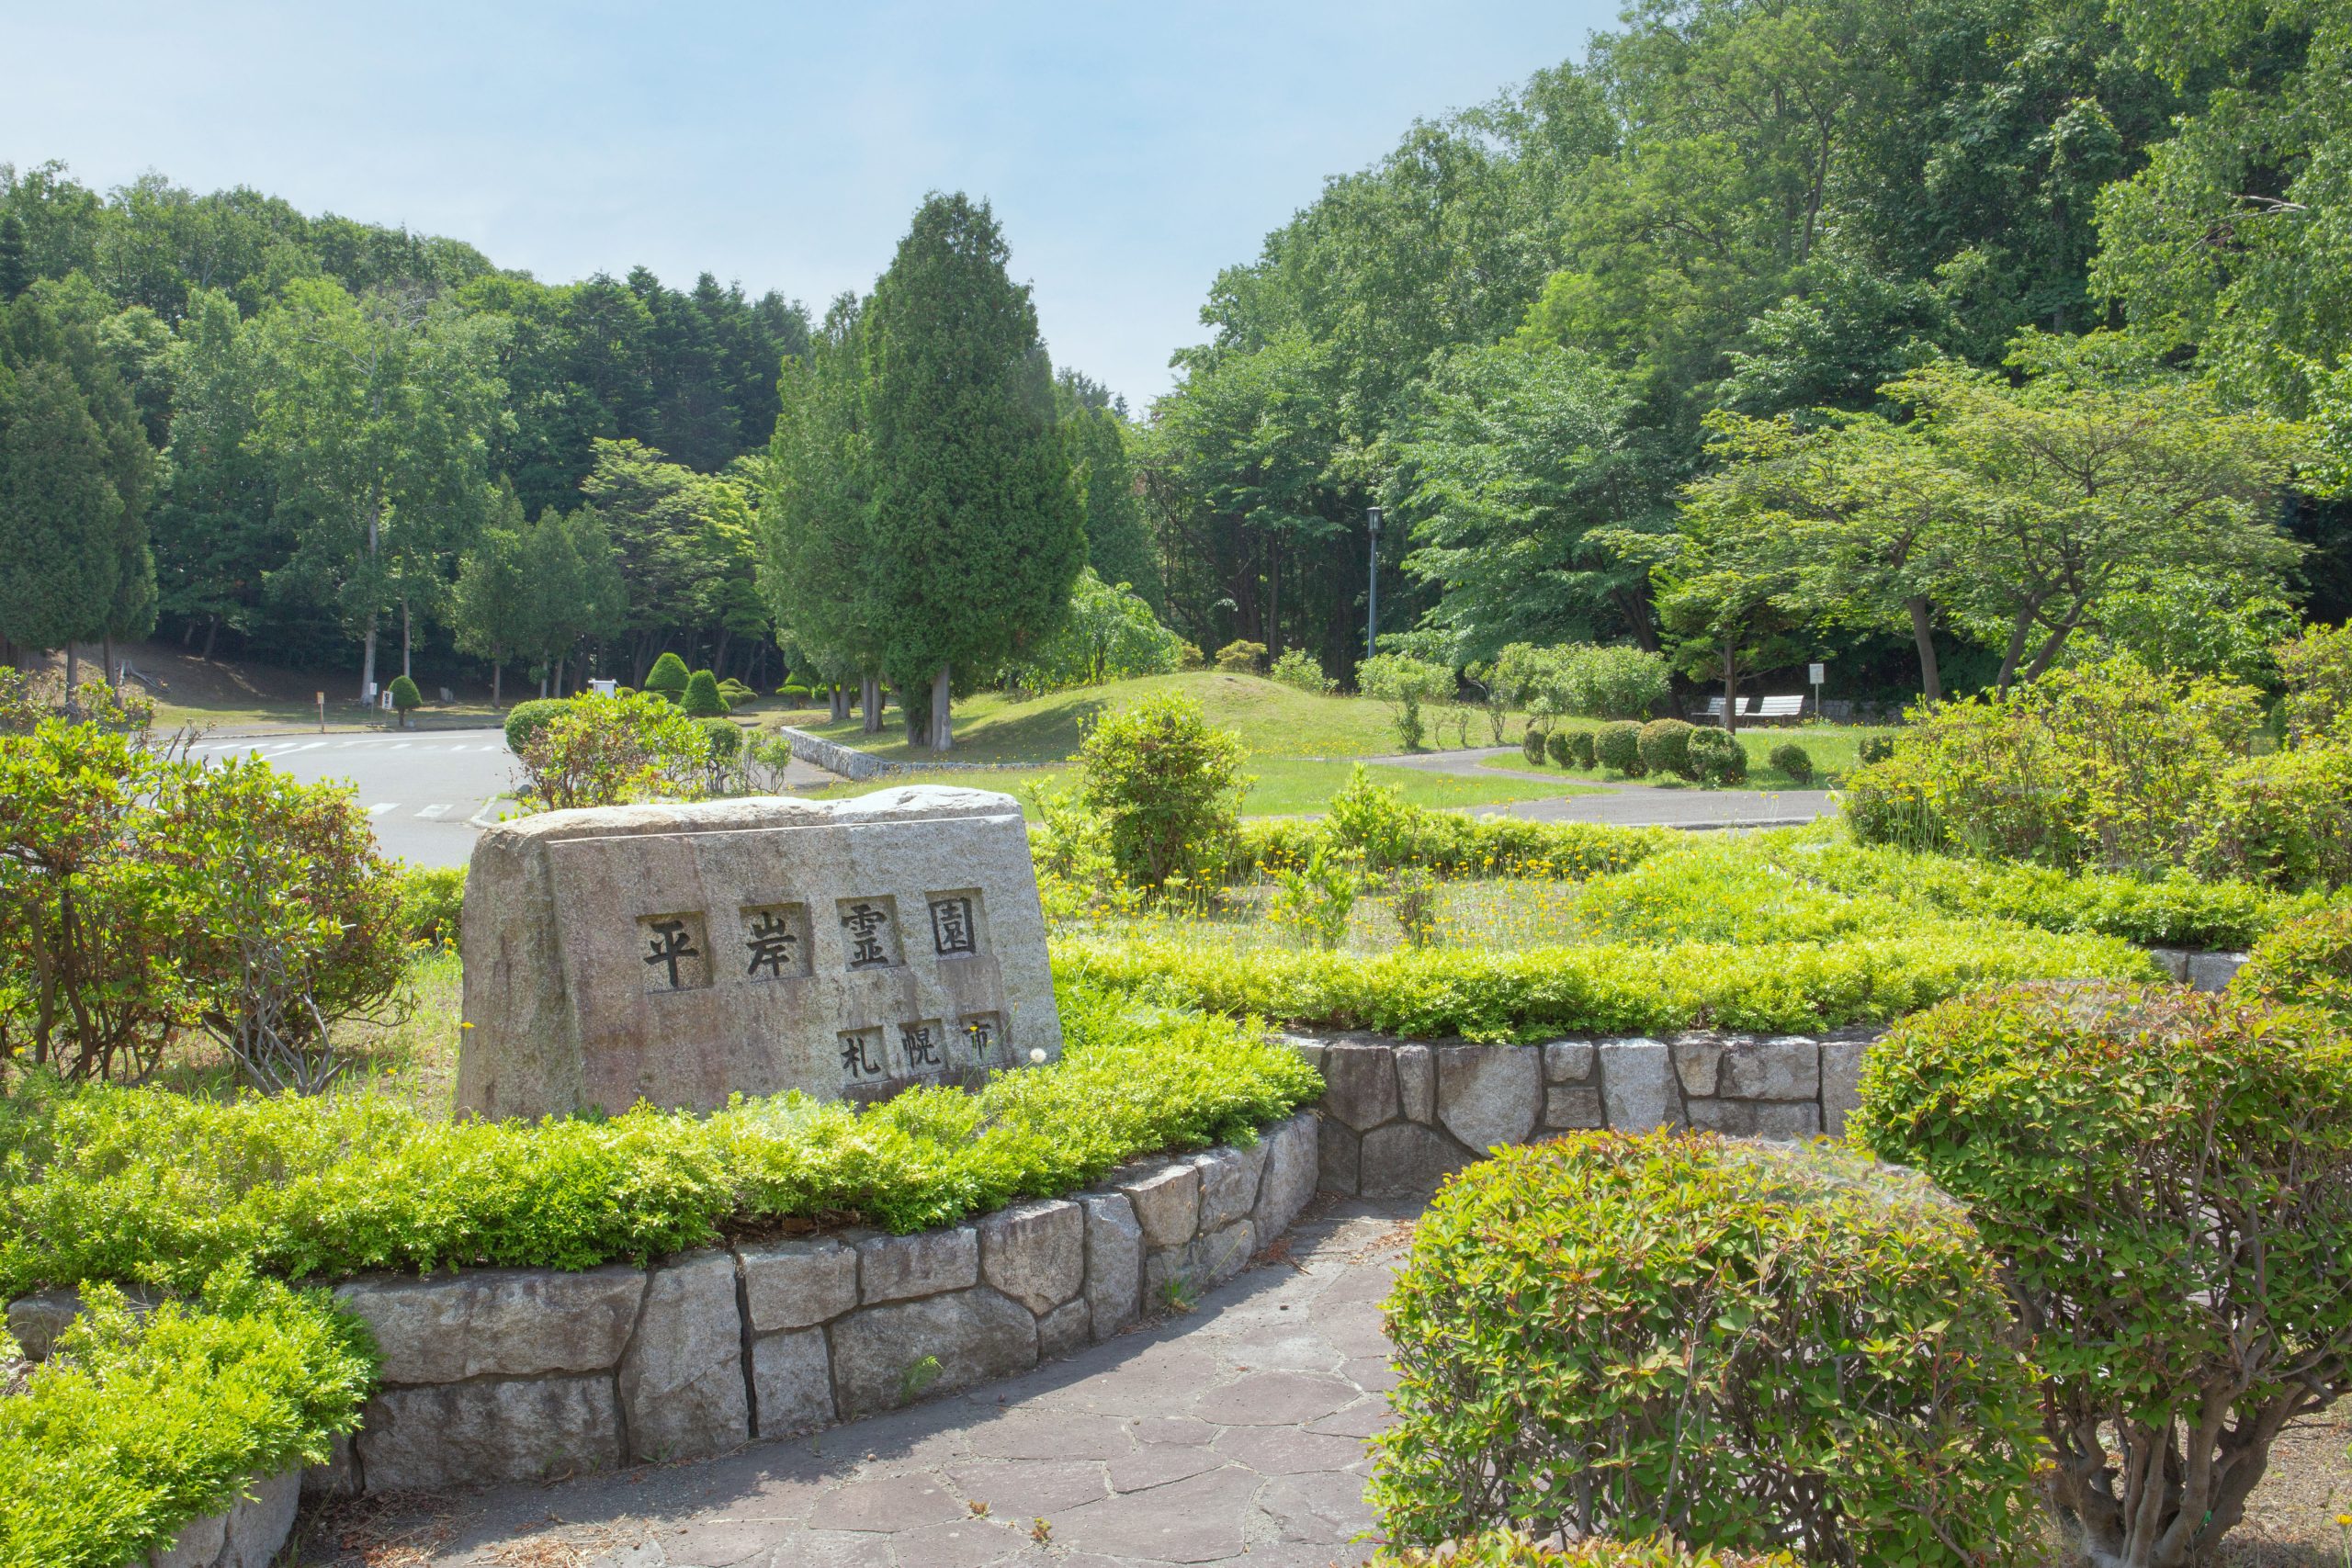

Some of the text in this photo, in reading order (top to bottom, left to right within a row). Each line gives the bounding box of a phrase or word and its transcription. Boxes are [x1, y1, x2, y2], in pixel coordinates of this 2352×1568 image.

[643, 897, 977, 989] 平岸霊園
[840, 1021, 991, 1078] 札幌市
